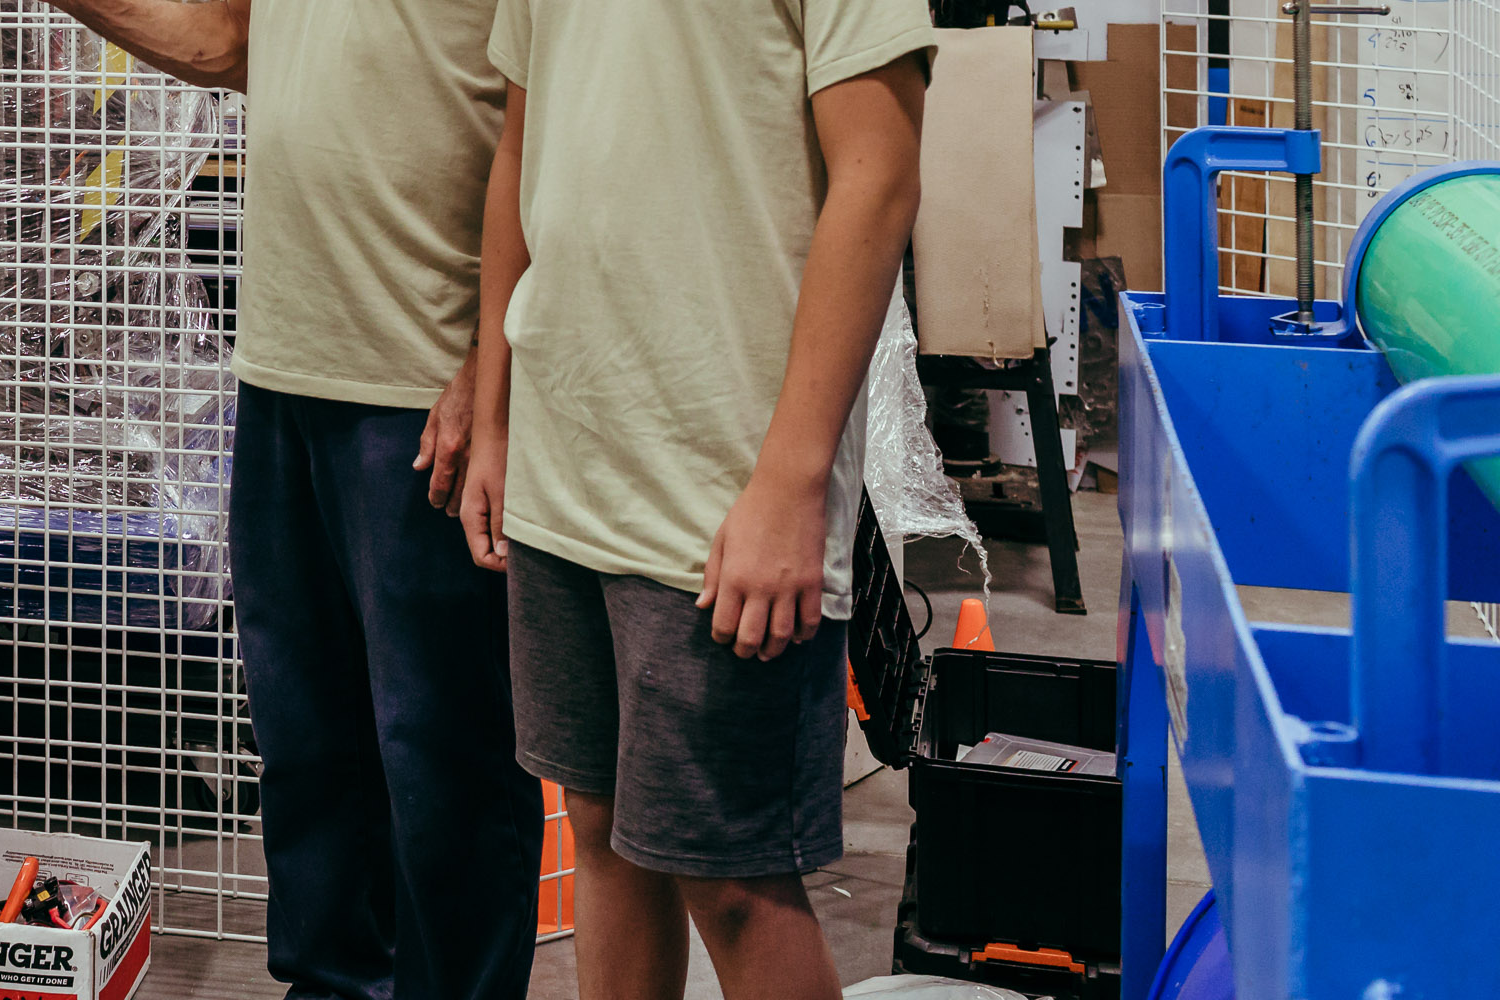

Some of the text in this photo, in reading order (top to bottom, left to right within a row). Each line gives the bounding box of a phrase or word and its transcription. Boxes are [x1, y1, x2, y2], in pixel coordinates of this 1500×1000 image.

[100, 850, 151, 960] GRAINGER
[0, 973, 19, 982] WHO
[20, 975, 35, 984] GET
[36, 976, 45, 984] IT
[45, 977, 68, 986] DONE
